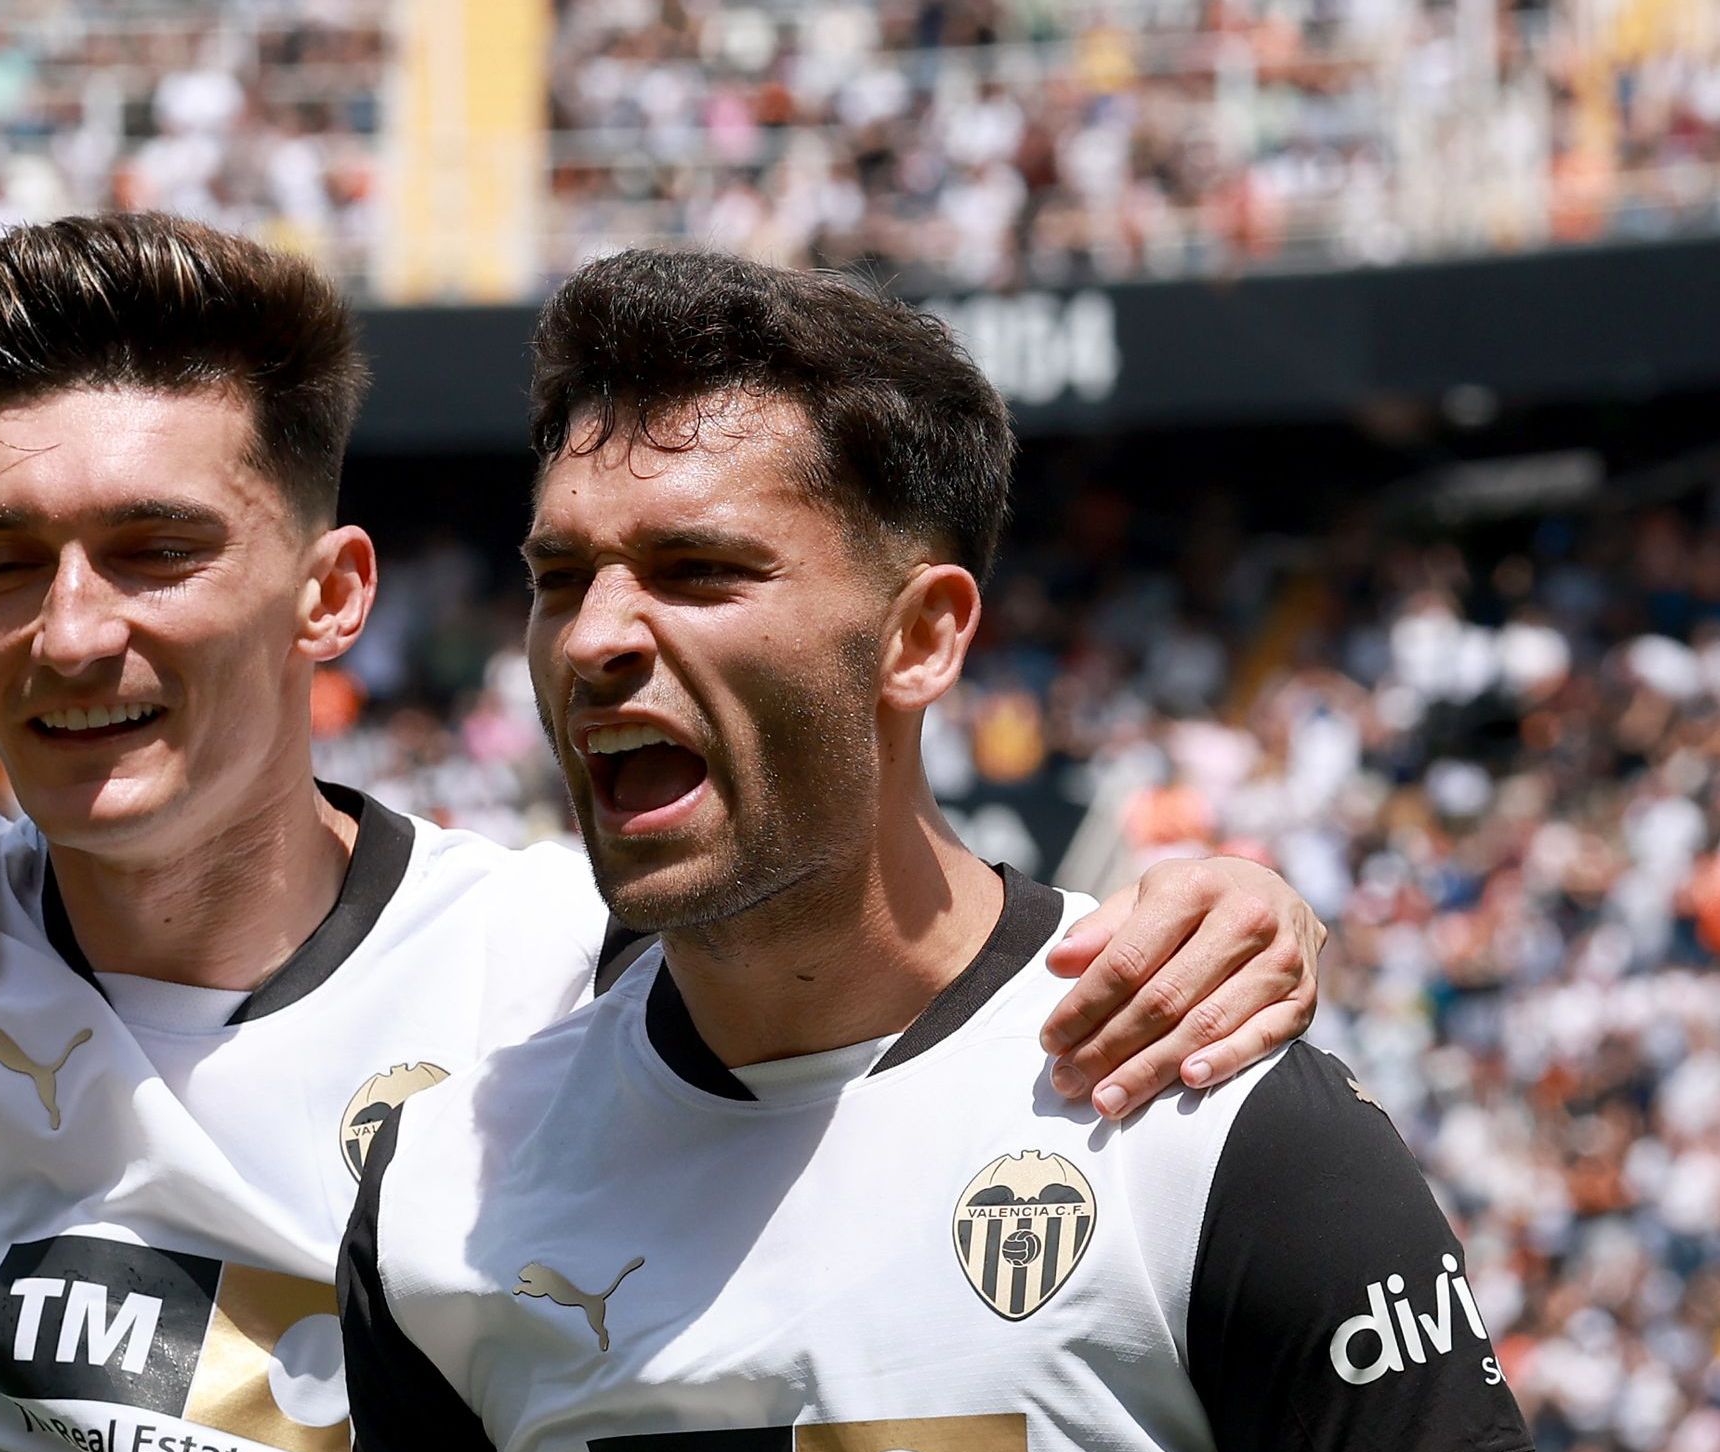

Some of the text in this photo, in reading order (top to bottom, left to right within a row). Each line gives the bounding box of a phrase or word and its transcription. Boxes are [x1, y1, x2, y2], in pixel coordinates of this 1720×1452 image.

[968, 1206, 1049, 1219] VALENCIA
[10, 1277, 163, 1375] TM
[1330, 1253, 1488, 1385] divi
